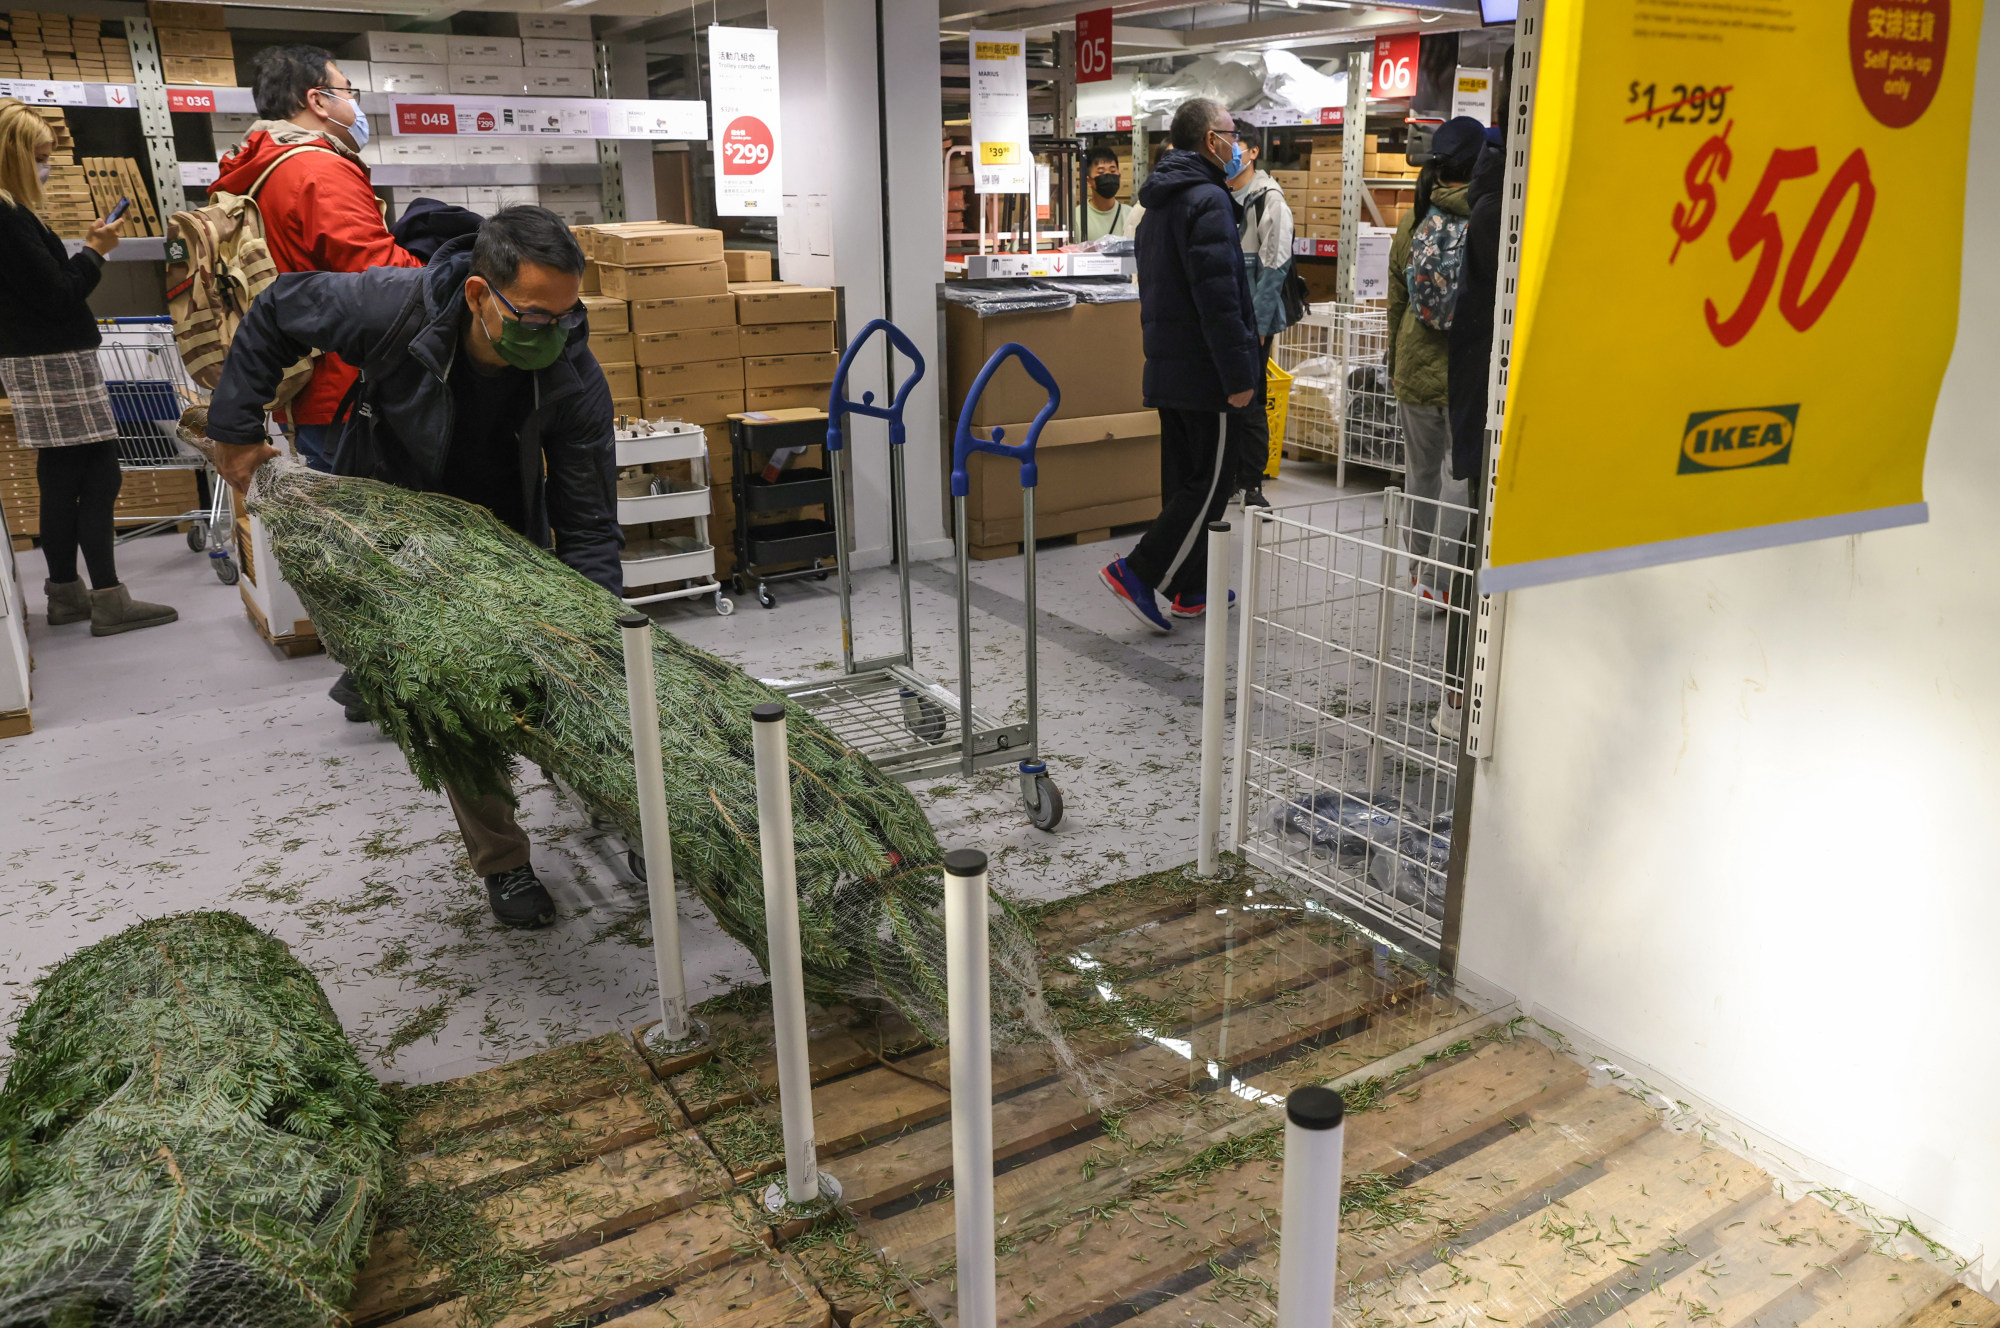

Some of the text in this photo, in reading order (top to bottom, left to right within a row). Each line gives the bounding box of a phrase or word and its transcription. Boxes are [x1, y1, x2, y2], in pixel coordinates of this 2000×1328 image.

[1867, 6, 1935, 42] 安排送貨
[718, 62, 736, 70] Trolley
[1081, 37, 1106, 74] 05
[1863, 49, 1932, 77] Self pick-up
[1379, 56, 1410, 90] 06
[186, 96, 211, 107] 03G
[1883, 76, 1912, 101] only
[1627, 79, 1727, 130] $1,299
[421, 112, 450, 126] 04B
[478, 120, 495, 128] $299
[724, 142, 769, 165] $299
[1669, 117, 1877, 348] $50
[1693, 422, 1784, 454] IKEA
